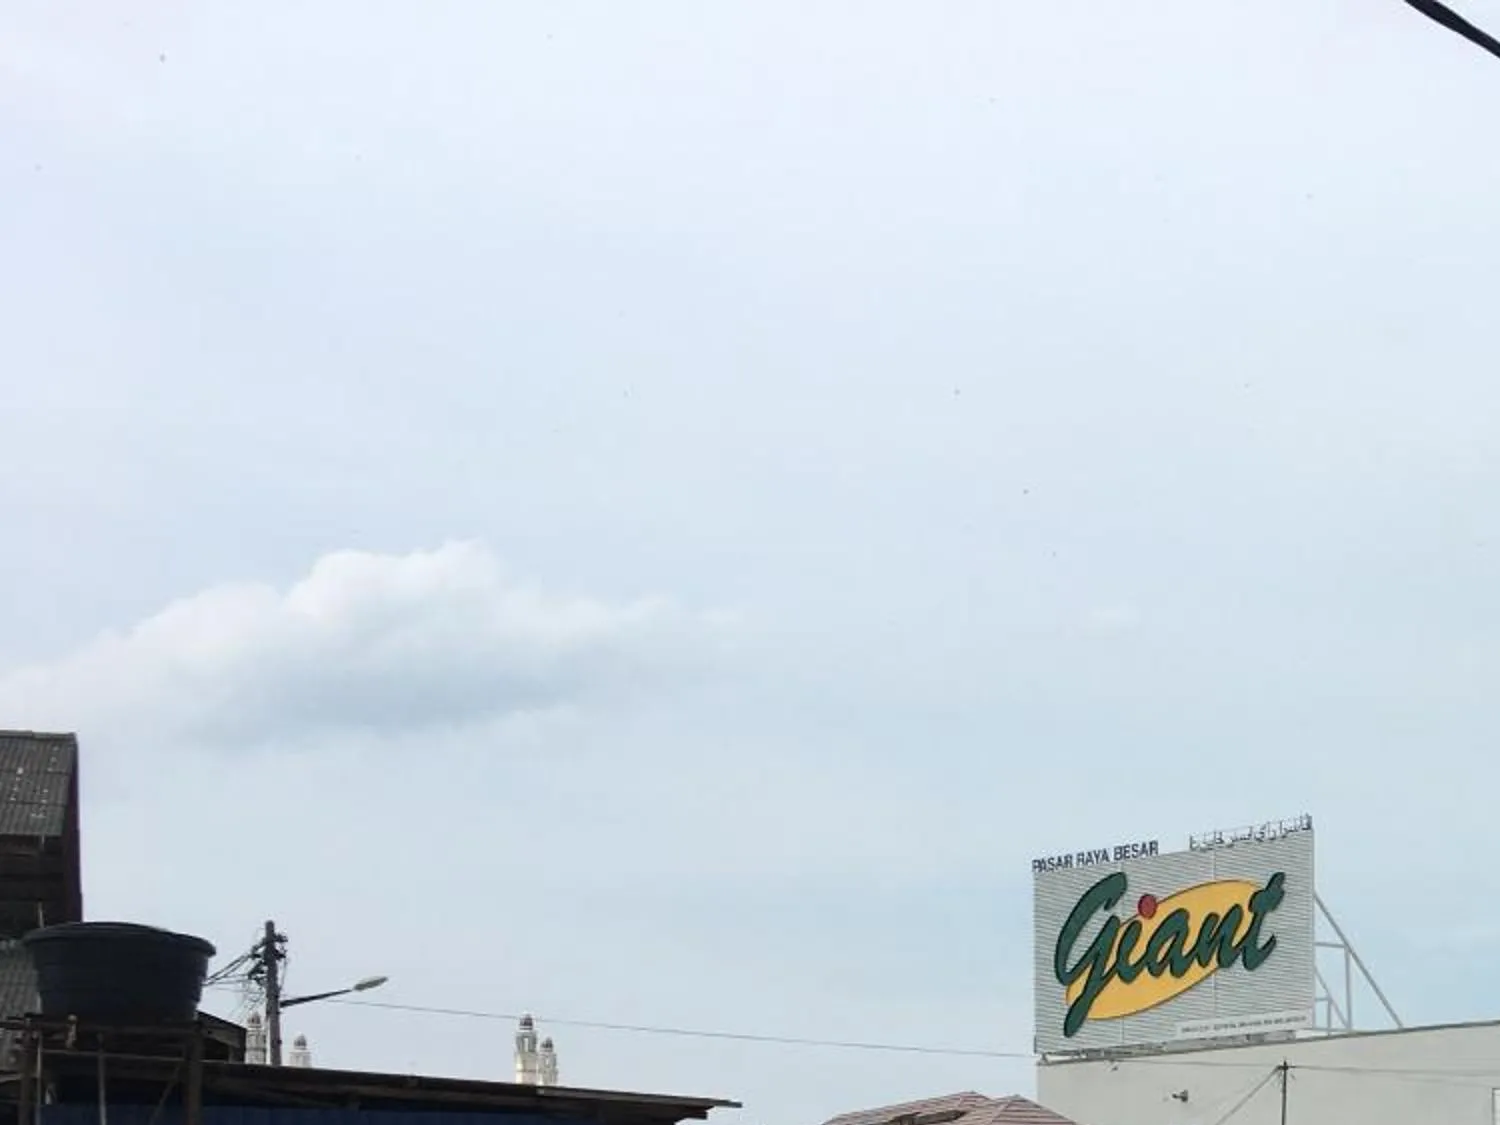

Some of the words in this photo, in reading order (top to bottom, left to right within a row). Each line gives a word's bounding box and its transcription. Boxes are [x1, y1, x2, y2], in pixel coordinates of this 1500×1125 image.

[1032, 854, 1073, 872] PASAR
[1076, 847, 1110, 866] RAYA
[1113, 840, 1159, 860] BESAR
